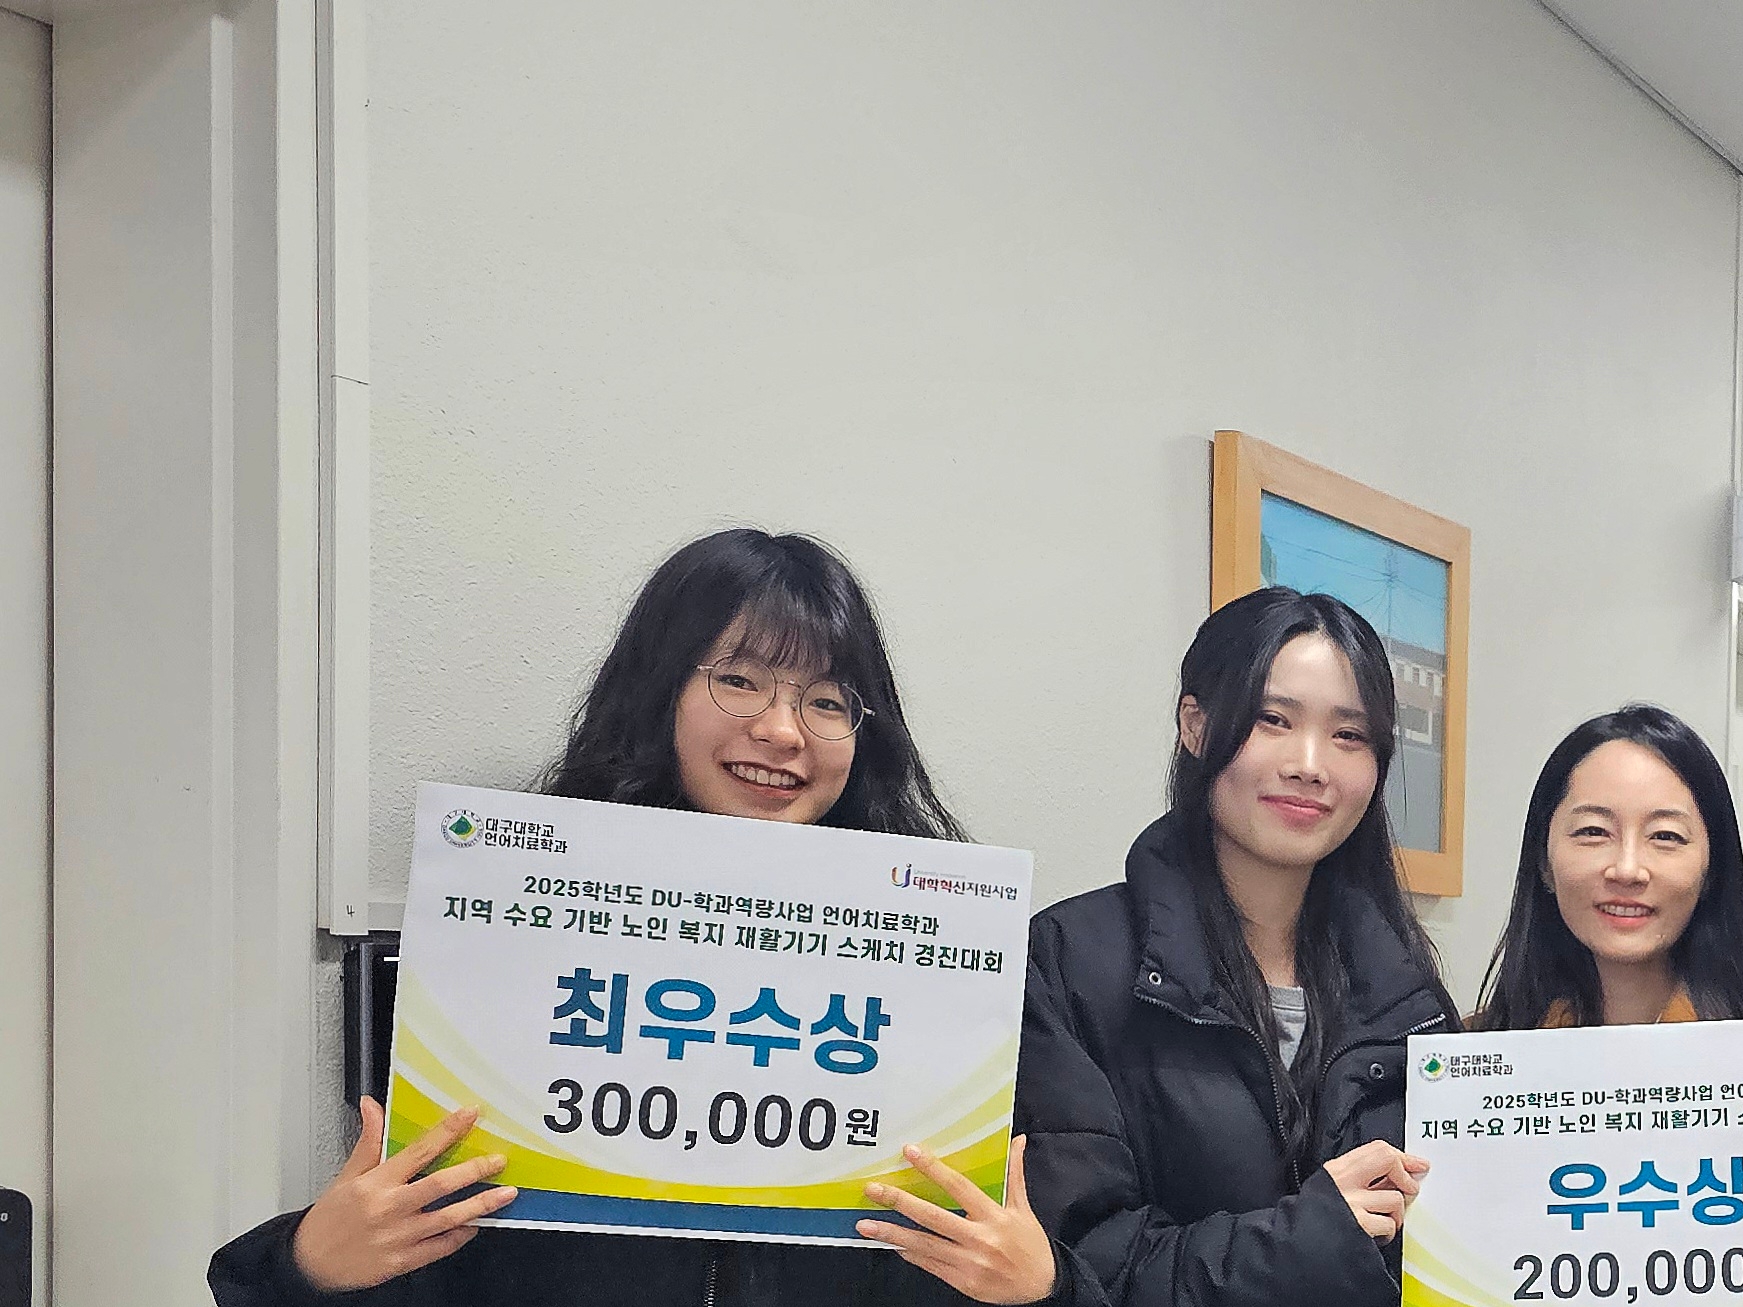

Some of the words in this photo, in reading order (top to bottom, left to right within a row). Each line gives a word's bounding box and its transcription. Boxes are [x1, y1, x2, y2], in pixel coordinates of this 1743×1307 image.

[485, 818, 554, 838] 대구대학교
[484, 832, 568, 853] 언어치료학과
[913, 876, 1018, 900] 대학혁신지원사업
[524, 876, 643, 905] 2025학년도
[651, 889, 814, 923] DU-학과역량사업
[823, 905, 940, 937] 언어치료학과
[443, 896, 493, 924] 지역
[503, 903, 552, 929] 수요
[563, 908, 612, 935] 기반
[621, 914, 668, 941] 노인
[678, 919, 724, 947] 복지
[734, 925, 828, 956] 재활기기
[837, 937, 905, 964] 스케치
[914, 943, 1003, 974] 경진대회
[549, 967, 892, 1075] 최우수상
[1451, 1054, 1503, 1066] 대구대학교
[1451, 1065, 1513, 1078] 언어치료학과
[1483, 1091, 1575, 1110] 2025학년도
[1582, 1084, 1713, 1106] DU-학과역량사업
[543, 1078, 882, 1151] 300,000원
[1421, 1119, 1458, 1140] 지역
[1467, 1117, 1505, 1138] 수요
[1513, 1115, 1551, 1136] 기반
[1559, 1113, 1596, 1134] 노인
[1605, 1111, 1642, 1132] 복지
[1652, 1107, 1729, 1130] 재활기기
